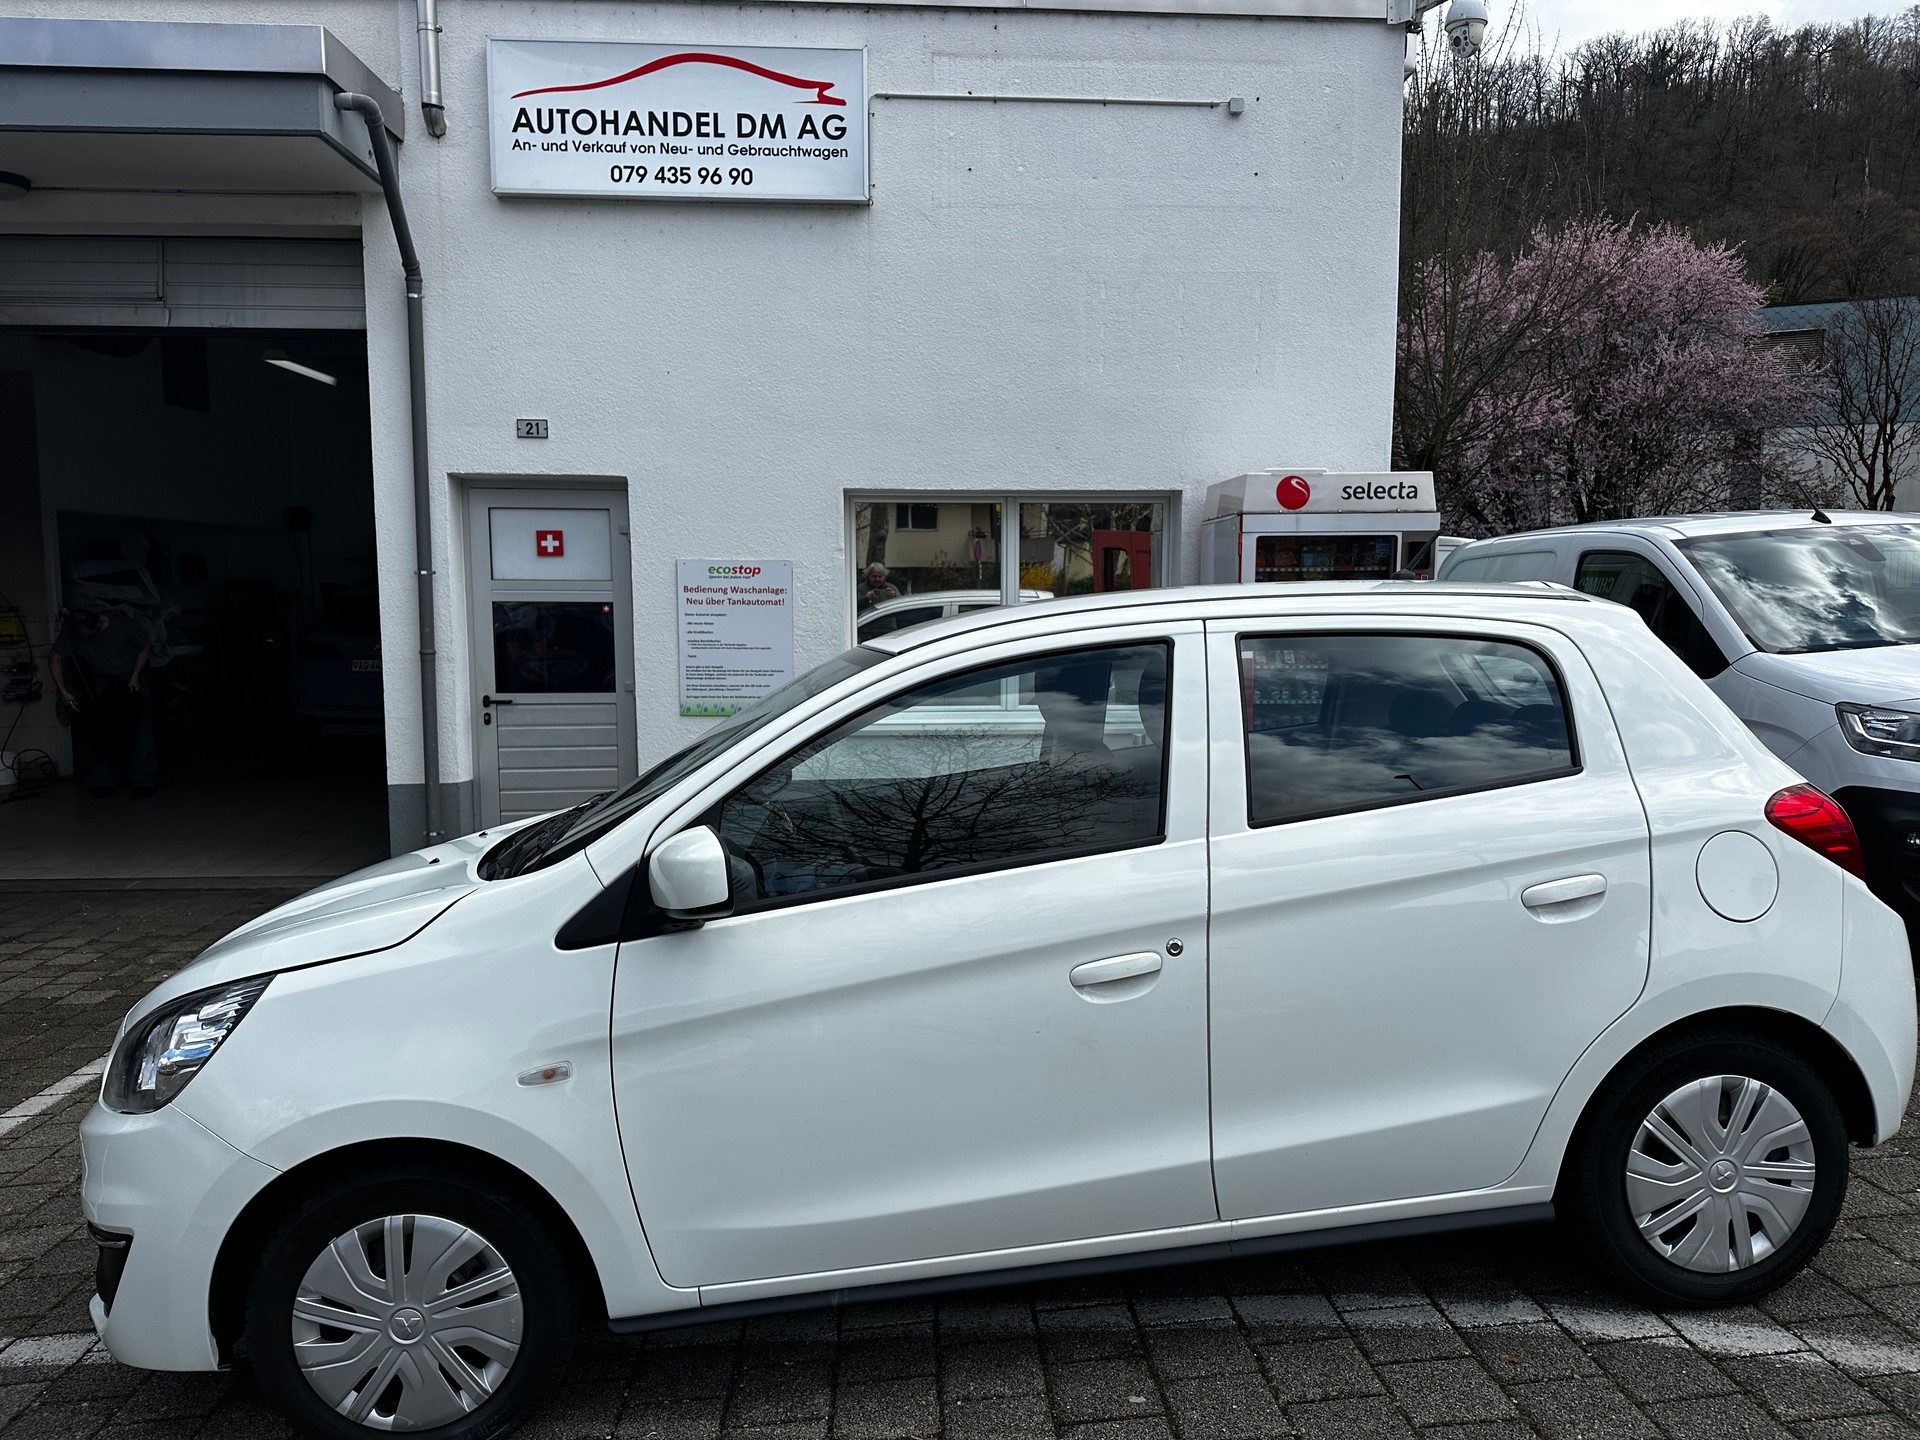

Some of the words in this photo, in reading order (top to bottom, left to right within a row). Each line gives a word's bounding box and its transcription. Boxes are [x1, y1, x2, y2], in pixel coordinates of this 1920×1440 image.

[511, 107, 726, 138] AUTOHANDEL
[736, 113, 788, 140] DM
[798, 114, 848, 141] AG
[512, 138, 537, 152] An-
[541, 140, 569, 154] und
[572, 141, 627, 155] Verkauf
[630, 144, 657, 155] von
[660, 142, 693, 155] Neu-
[697, 143, 724, 157] und
[727, 144, 849, 161] Gebrauchtwagen
[610, 165, 648, 184] 079
[654, 166, 691, 185] 435
[697, 167, 723, 186] 96
[729, 168, 754, 186] 90
[525, 422, 540, 435] 21
[1341, 482, 1418, 500] selecta
[708, 565, 761, 577] ecostop
[683, 585, 728, 595] Bedienung
[730, 586, 787, 595] Waschanlage:
[686, 597, 703, 605] Neu
[706, 597, 725, 606] über
[728, 597, 785, 606] Tankautomat!
